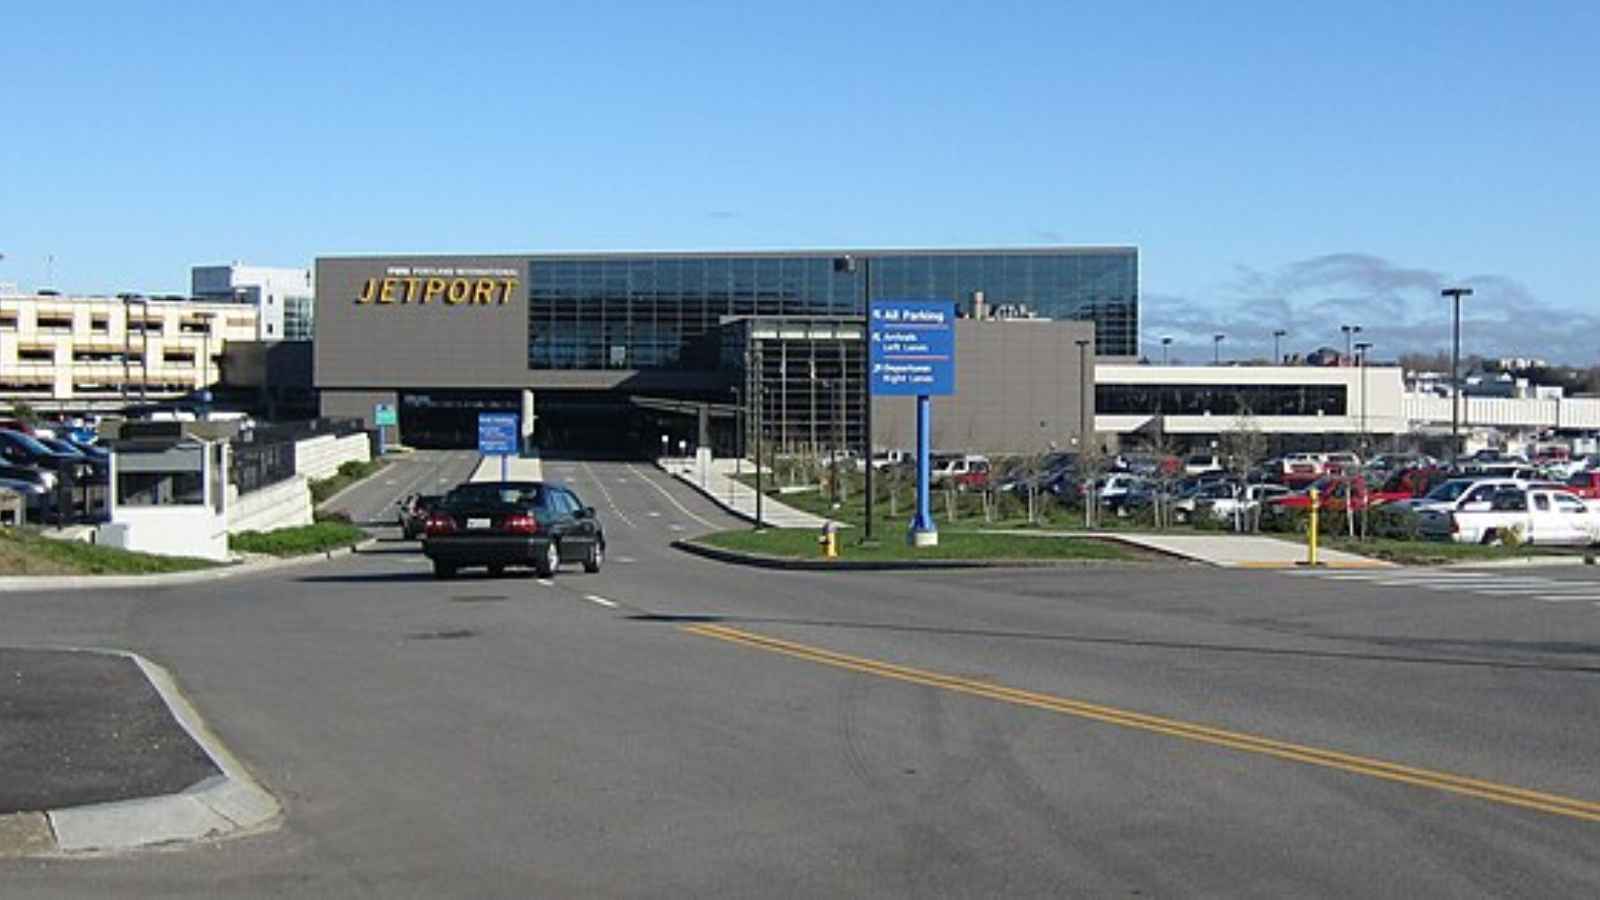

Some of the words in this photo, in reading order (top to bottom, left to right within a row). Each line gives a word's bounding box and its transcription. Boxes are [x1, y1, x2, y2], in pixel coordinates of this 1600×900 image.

[355, 277, 519, 304] JETPORT
[884, 309, 899, 320] All
[902, 309, 945, 323] Parking
[882, 343, 901, 352] Left
[882, 374, 906, 385] Right
